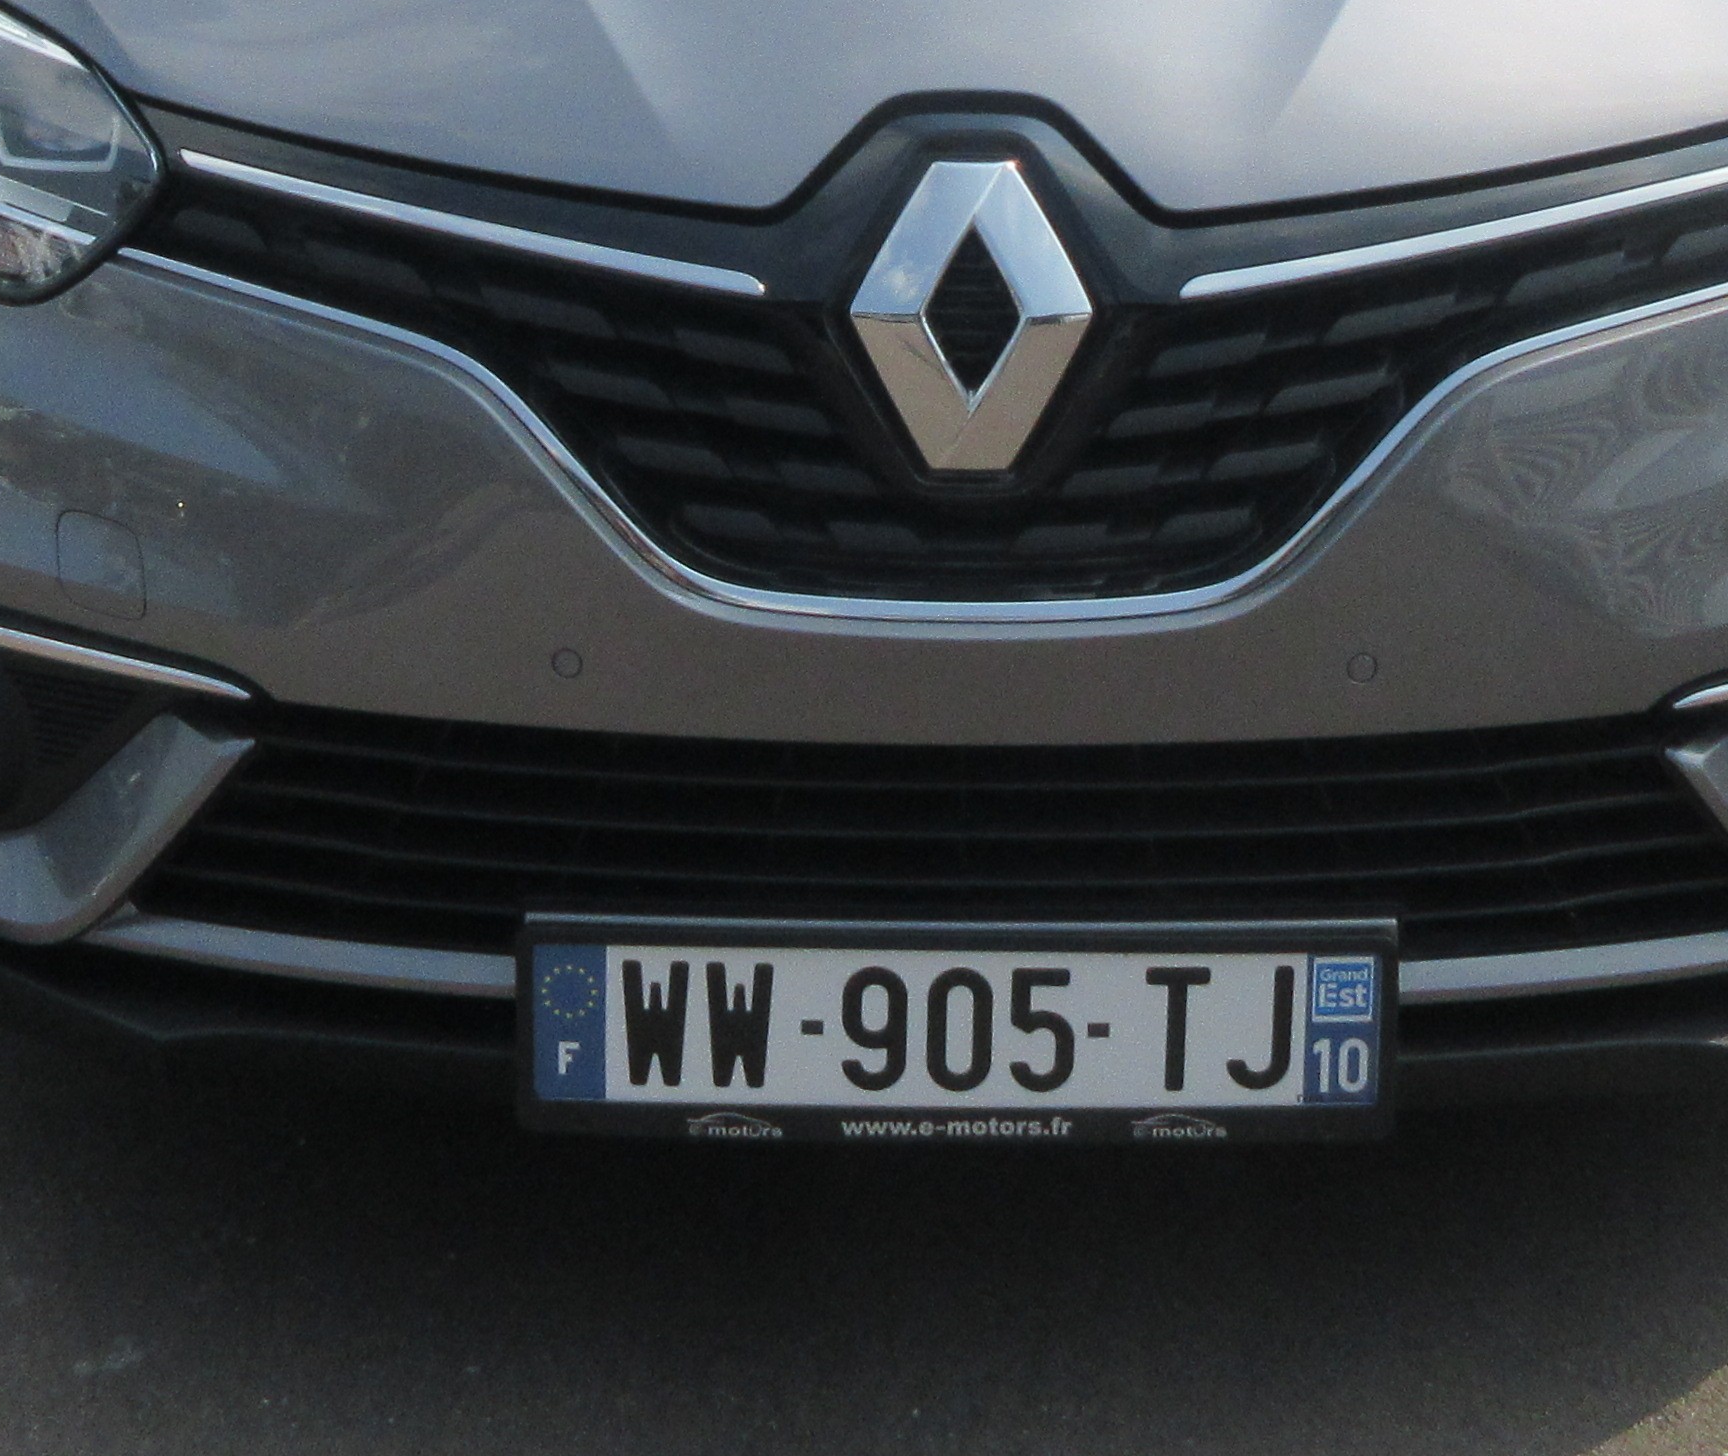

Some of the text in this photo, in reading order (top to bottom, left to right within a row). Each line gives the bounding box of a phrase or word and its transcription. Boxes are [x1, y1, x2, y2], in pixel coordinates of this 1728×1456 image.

[1319, 968, 1368, 982] Grand
[1318, 982, 1367, 1008] Est
[558, 1041, 580, 1075] F
[1313, 1037, 1369, 1093] 10
[841, 1117, 1072, 1137] www.e-motors.fr
